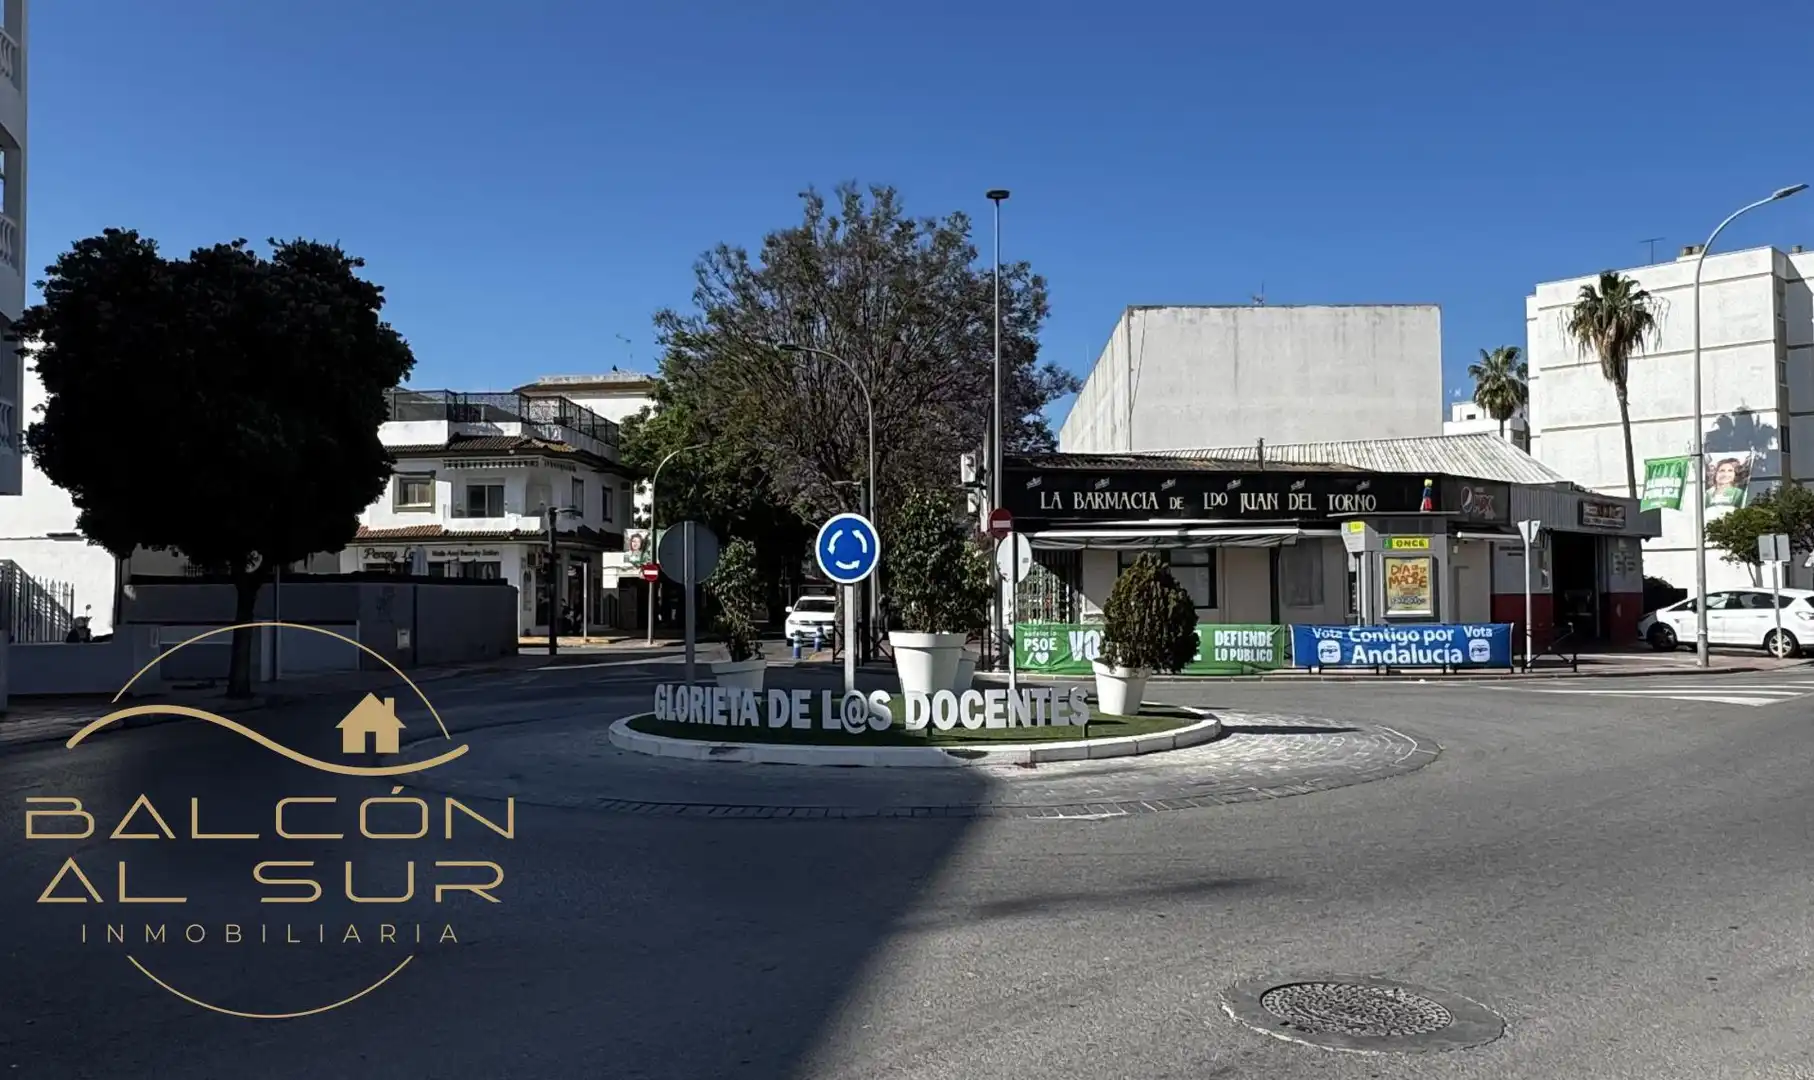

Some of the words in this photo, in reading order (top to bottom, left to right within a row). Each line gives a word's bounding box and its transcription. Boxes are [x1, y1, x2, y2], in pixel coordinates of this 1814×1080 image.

[1040, 491, 1063, 510] LA
[1073, 491, 1160, 510] BARMACIA
[1169, 496, 1185, 510] DE
[1203, 492, 1228, 510] LDO
[1240, 492, 1279, 513] JUAN
[1288, 493, 1317, 511] DEL
[1327, 493, 1377, 512] TORNO
[1396, 539, 1425, 548] ONCE
[1214, 630, 1273, 647] DEFIENDE
[1312, 627, 1343, 639] Vota
[1349, 628, 1421, 645] Contigo
[1423, 629, 1455, 645] por
[1463, 625, 1493, 638] Vota
[1023, 637, 1058, 651] PSOE
[1214, 648, 1229, 661] LO
[1351, 643, 1464, 664] Andalucía
[654, 683, 760, 727] GLORIETA
[768, 688, 812, 729] DE
[822, 688, 893, 734] L@S
[905, 686, 1090, 731] DOCENTES
